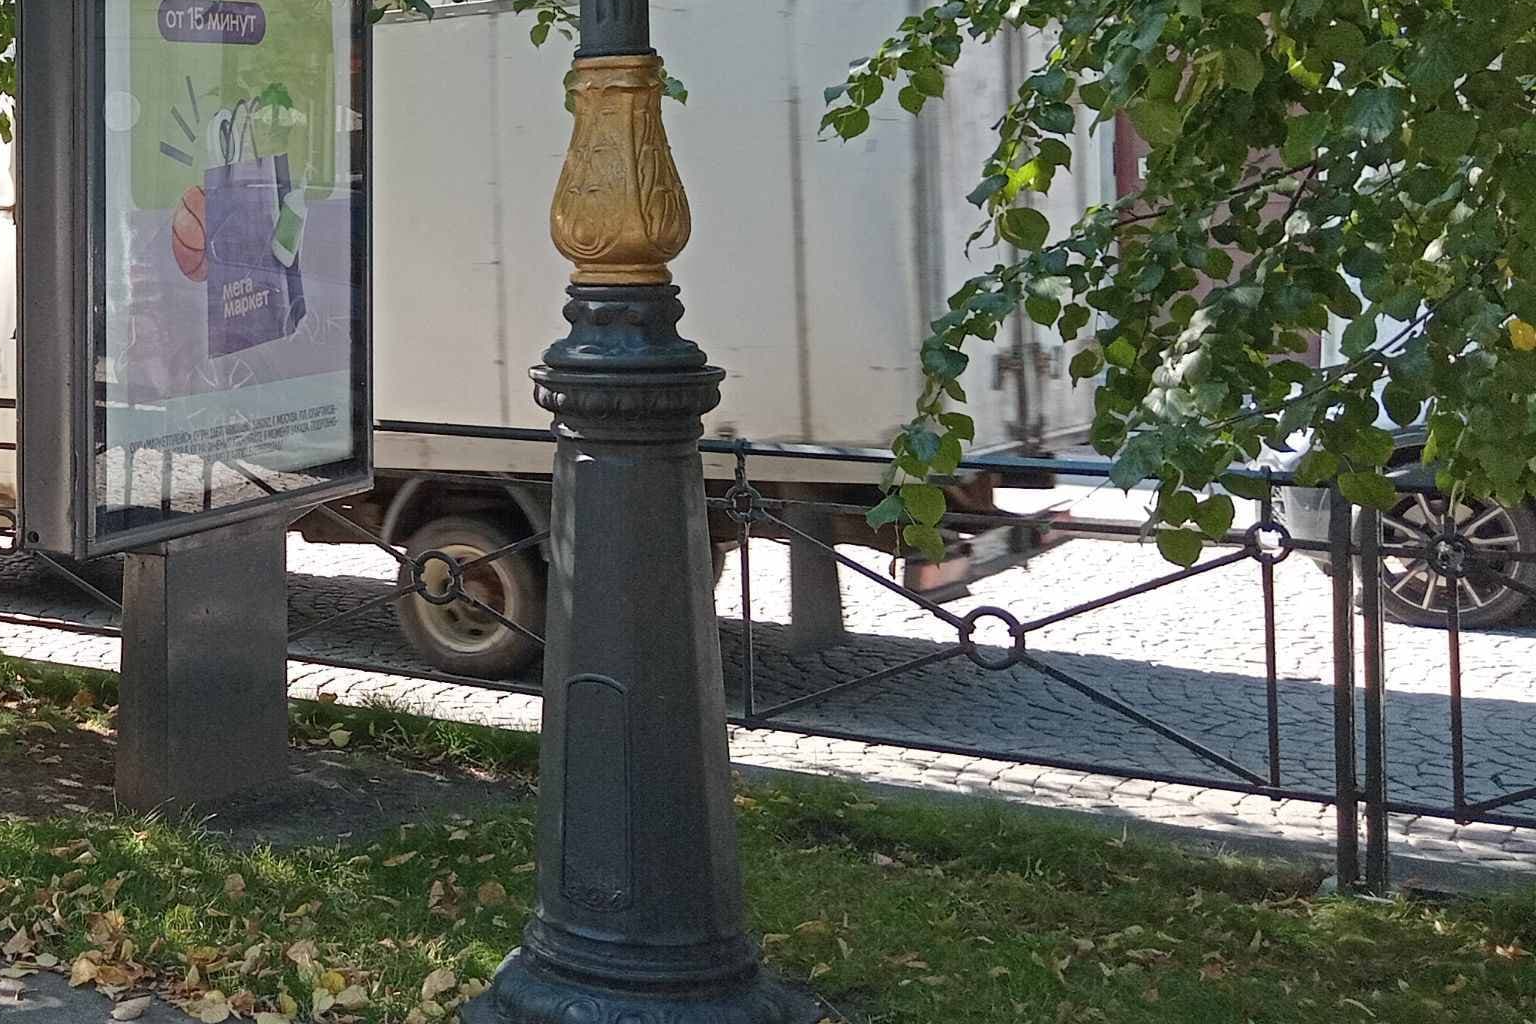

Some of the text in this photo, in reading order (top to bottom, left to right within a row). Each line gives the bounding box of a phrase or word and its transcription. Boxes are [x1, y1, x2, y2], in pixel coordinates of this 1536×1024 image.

[166, 6, 257, 37] от 15 минут
